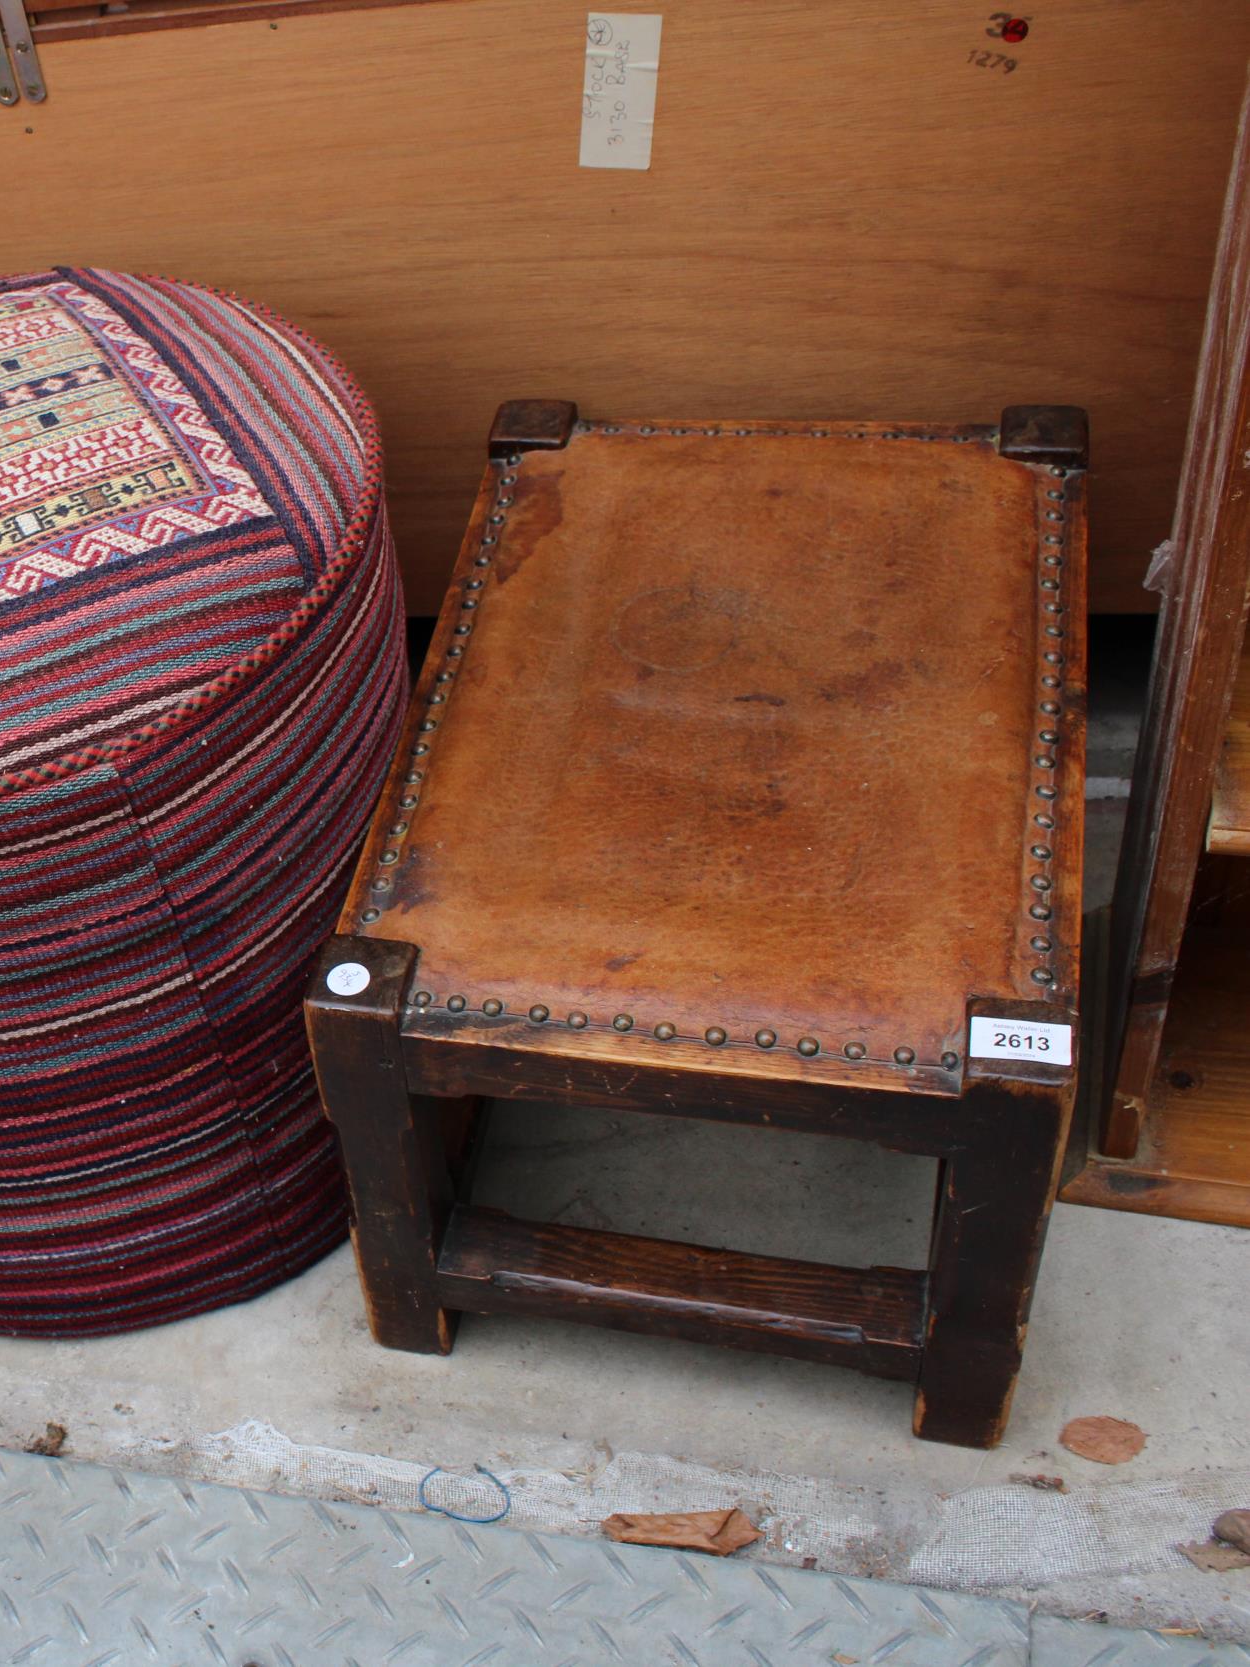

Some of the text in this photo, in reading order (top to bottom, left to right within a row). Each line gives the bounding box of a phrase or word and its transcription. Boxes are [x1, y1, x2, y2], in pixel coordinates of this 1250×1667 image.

[967, 49, 1018, 75] 1279
[607, 100, 627, 146] 3130
[993, 1033, 1050, 1051] 2613
